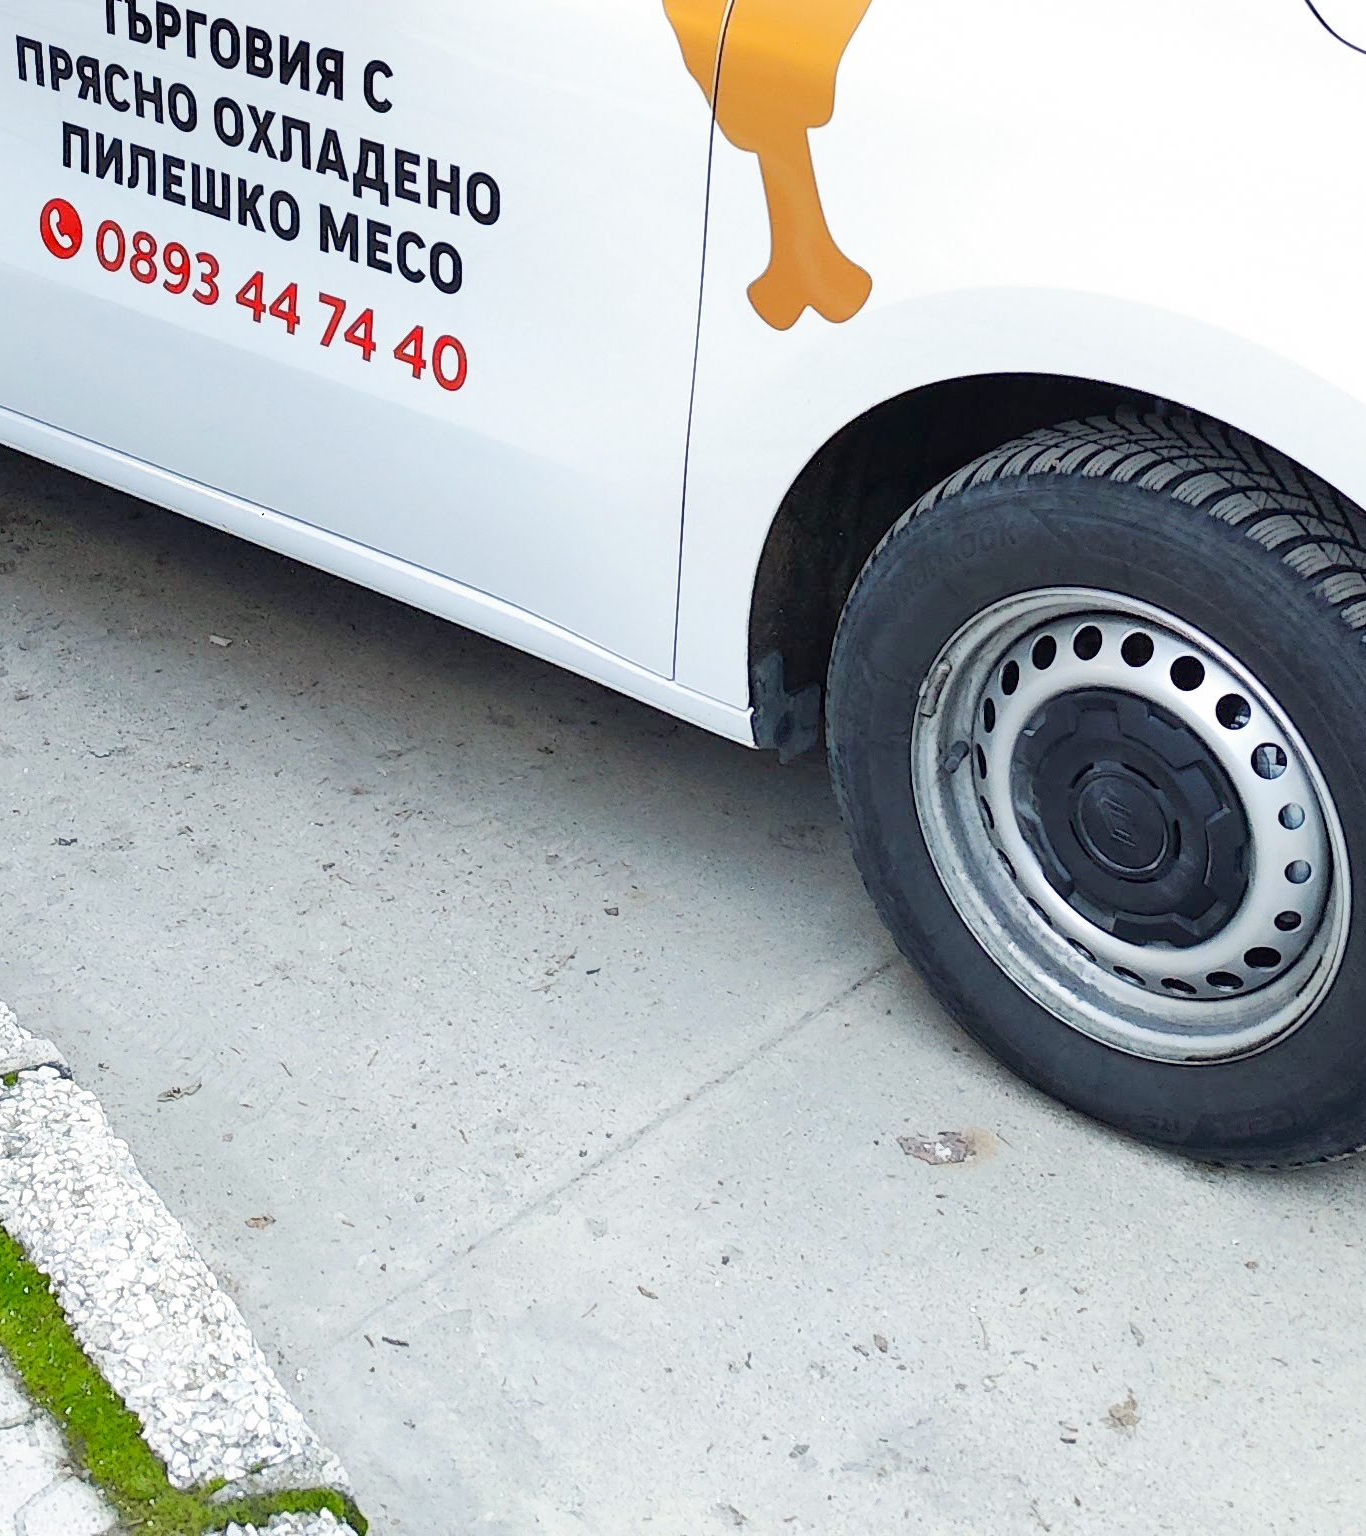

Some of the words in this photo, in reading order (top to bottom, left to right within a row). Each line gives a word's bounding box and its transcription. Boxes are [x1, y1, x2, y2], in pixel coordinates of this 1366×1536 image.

[15, 34, 198, 133] ПРЯСНО
[213, 96, 501, 226] ОХЛАДЕНО
[363, 59, 394, 114] С
[61, 121, 301, 242] ПИЛЕШКО
[319, 203, 464, 295] МЕСО
[95, 219, 220, 306] 0893
[235, 270, 301, 336] 44
[318, 291, 377, 362] 74
[392, 324, 468, 391] 40
